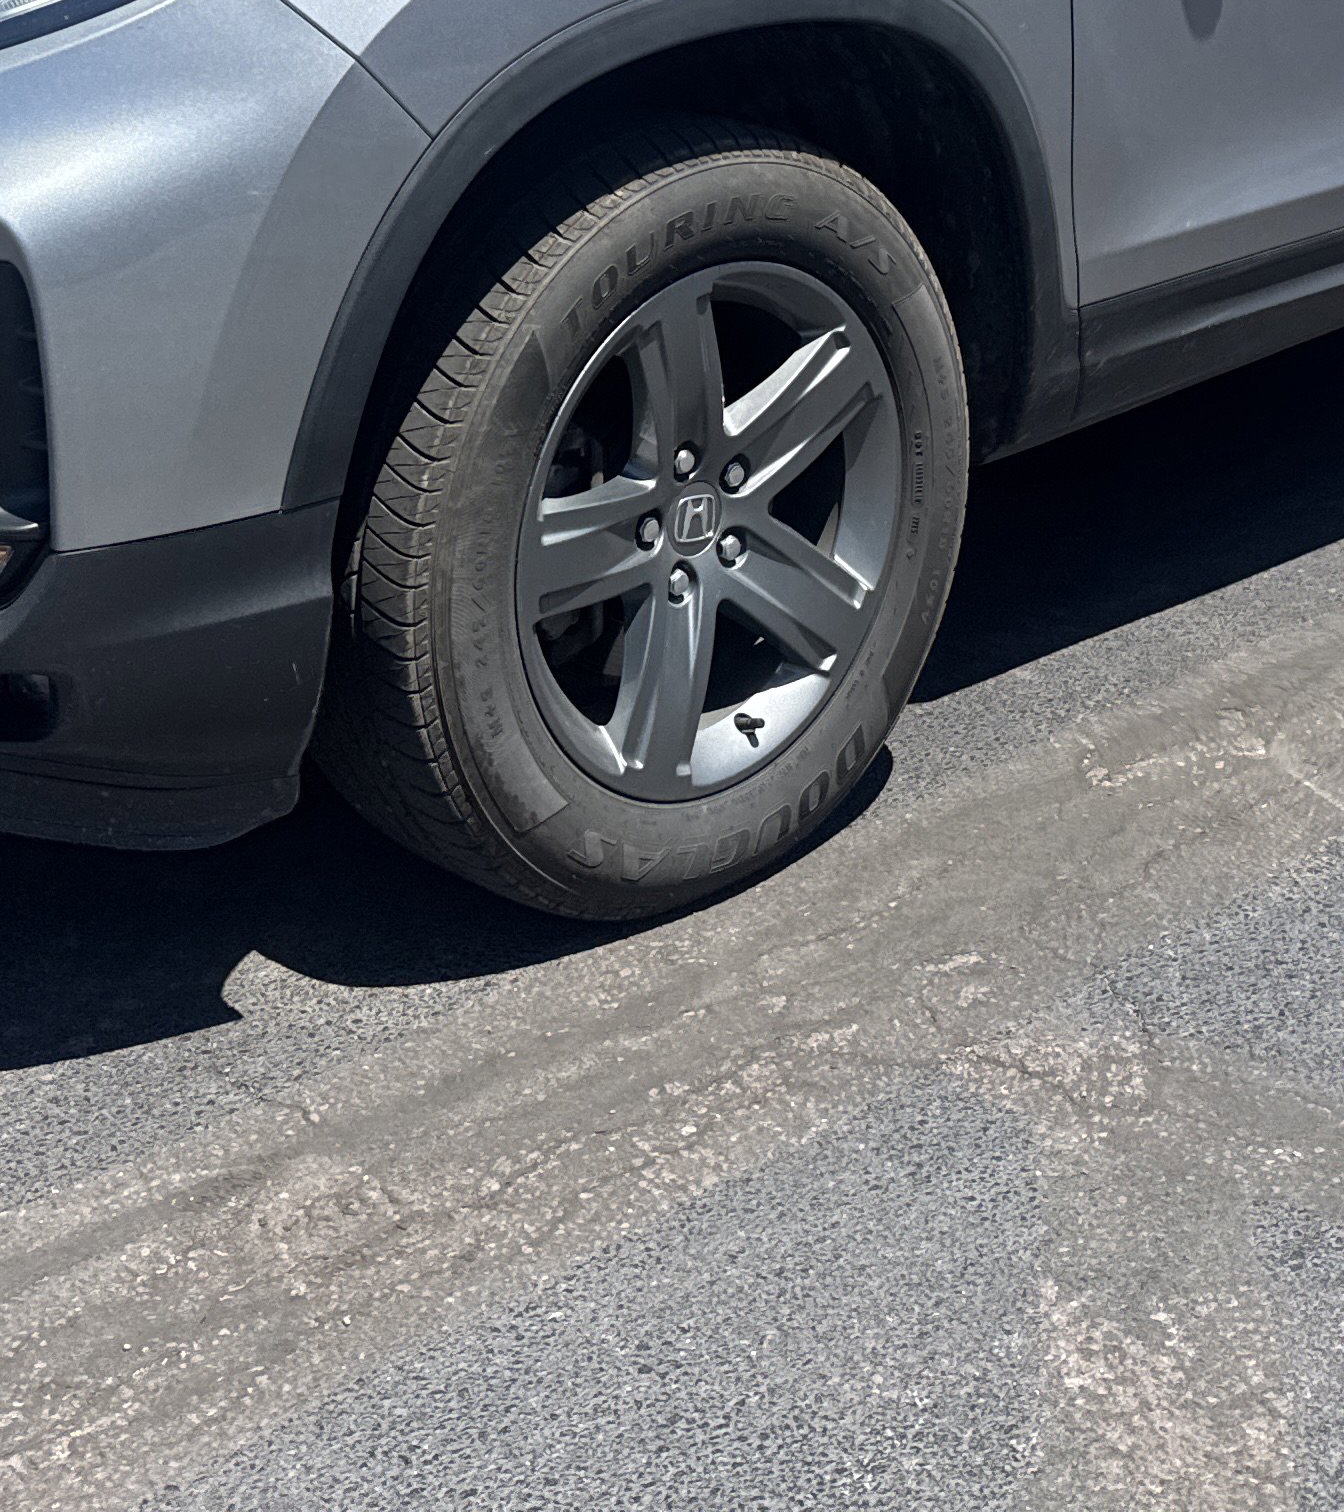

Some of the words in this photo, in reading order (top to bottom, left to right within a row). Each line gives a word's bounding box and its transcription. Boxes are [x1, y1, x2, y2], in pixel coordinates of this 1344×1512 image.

[560, 192, 797, 337] TOURING
[814, 209, 897, 276] A/S
[566, 723, 867, 882] DOUGLAS
